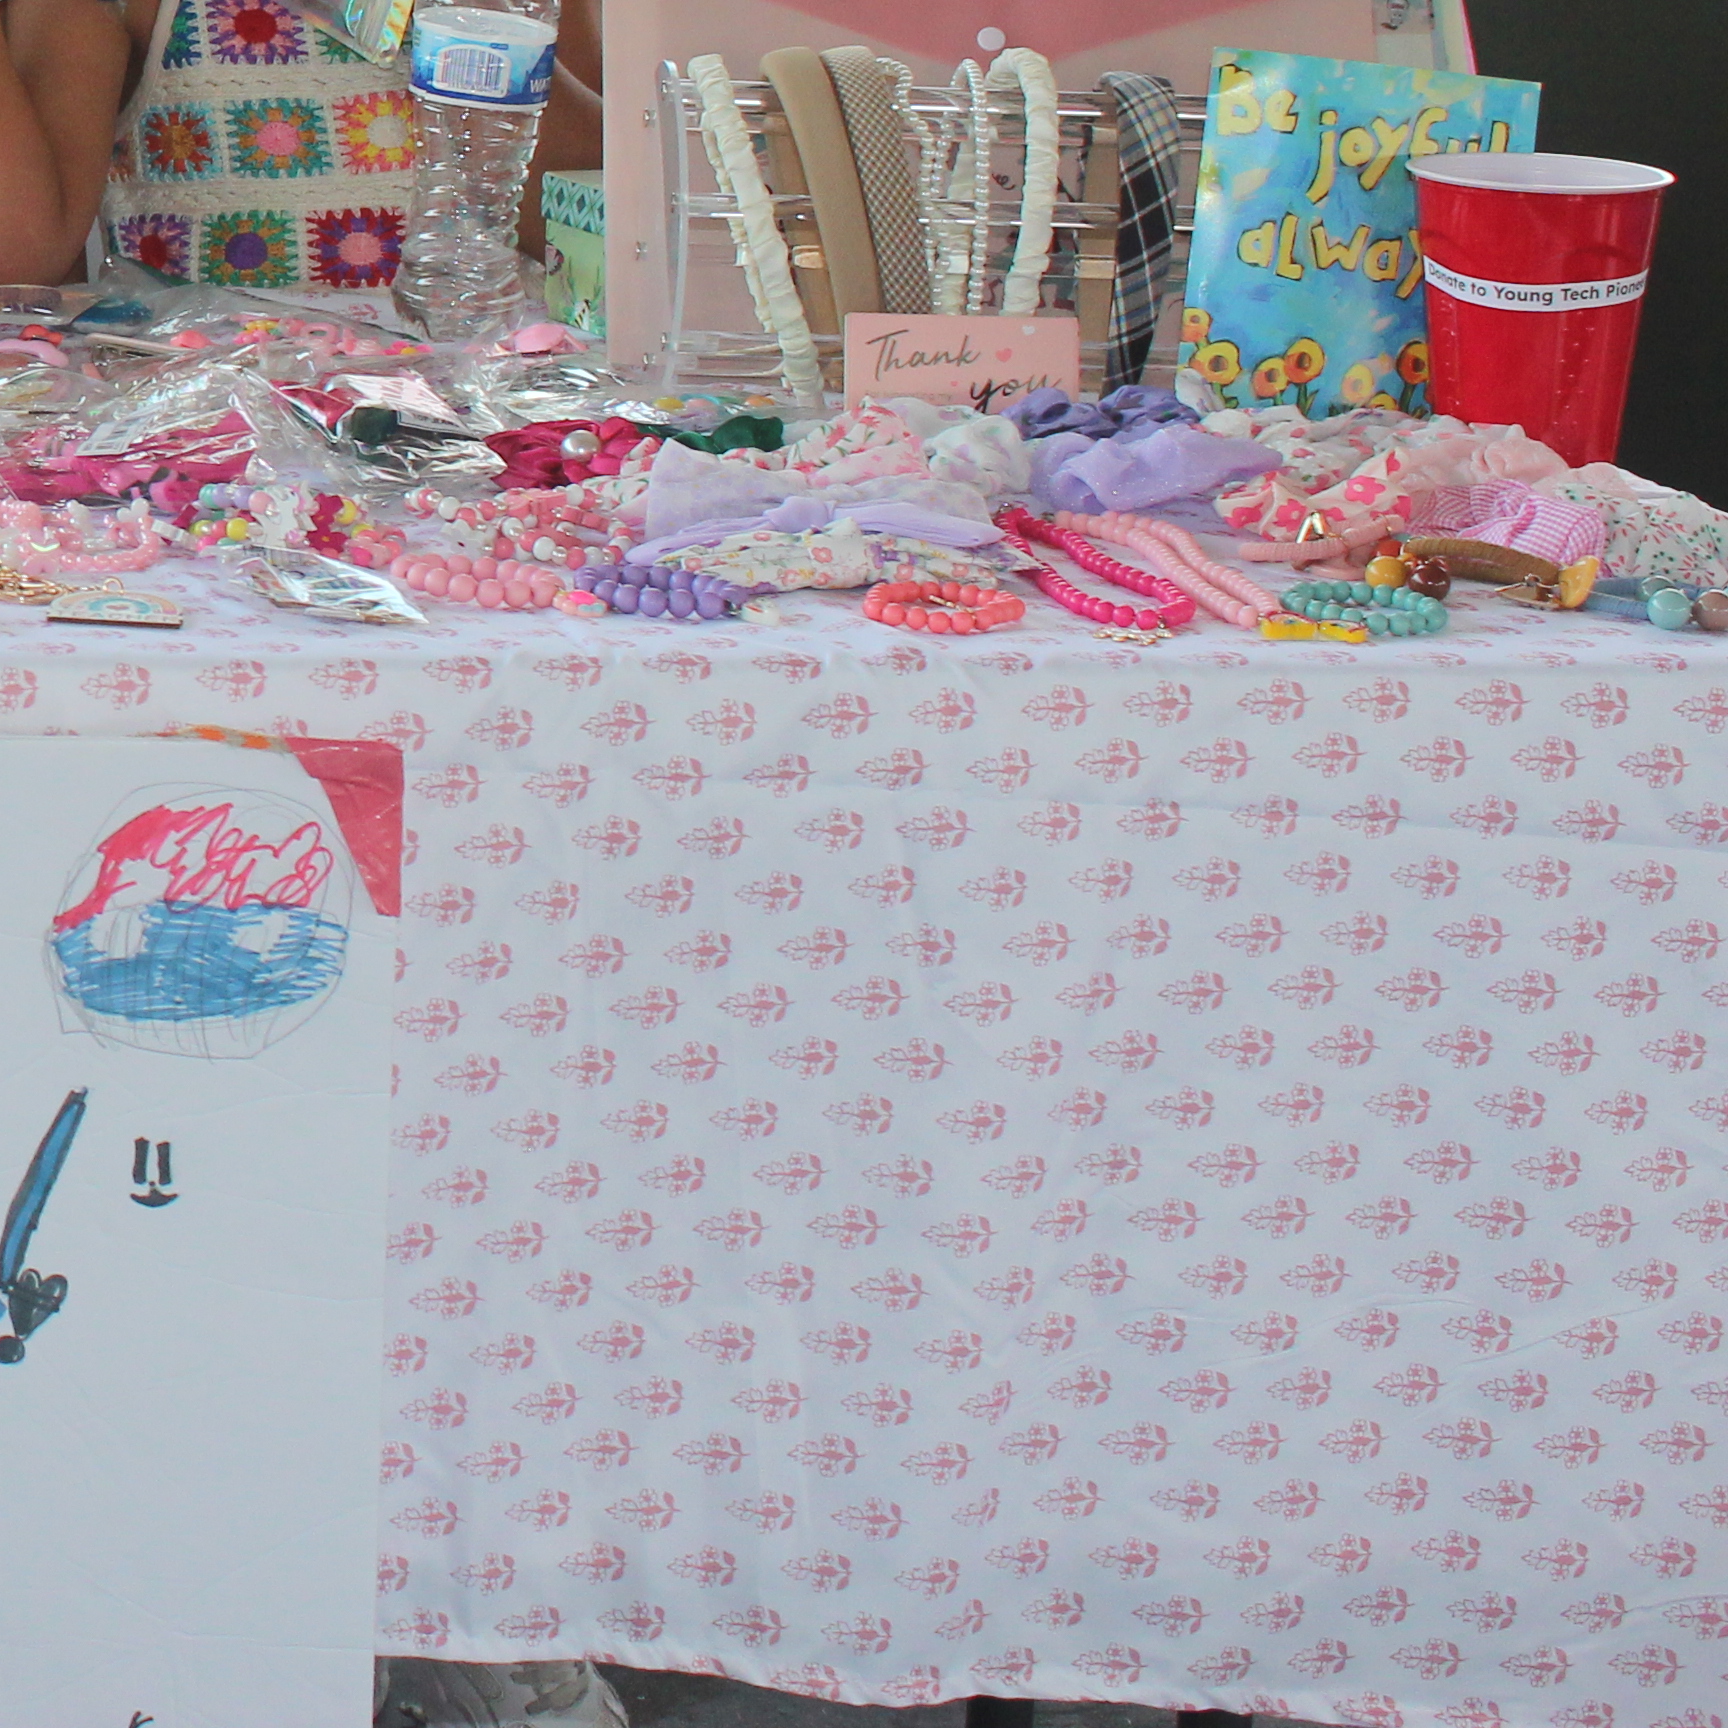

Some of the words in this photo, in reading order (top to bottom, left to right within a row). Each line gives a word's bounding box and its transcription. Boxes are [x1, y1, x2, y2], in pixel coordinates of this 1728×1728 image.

[1427, 262, 1466, 292] Donate
[1471, 281, 1487, 297] to
[1493, 285, 1554, 306] Young
[1561, 286, 1600, 302] Tech
[866, 329, 980, 382] Thank
